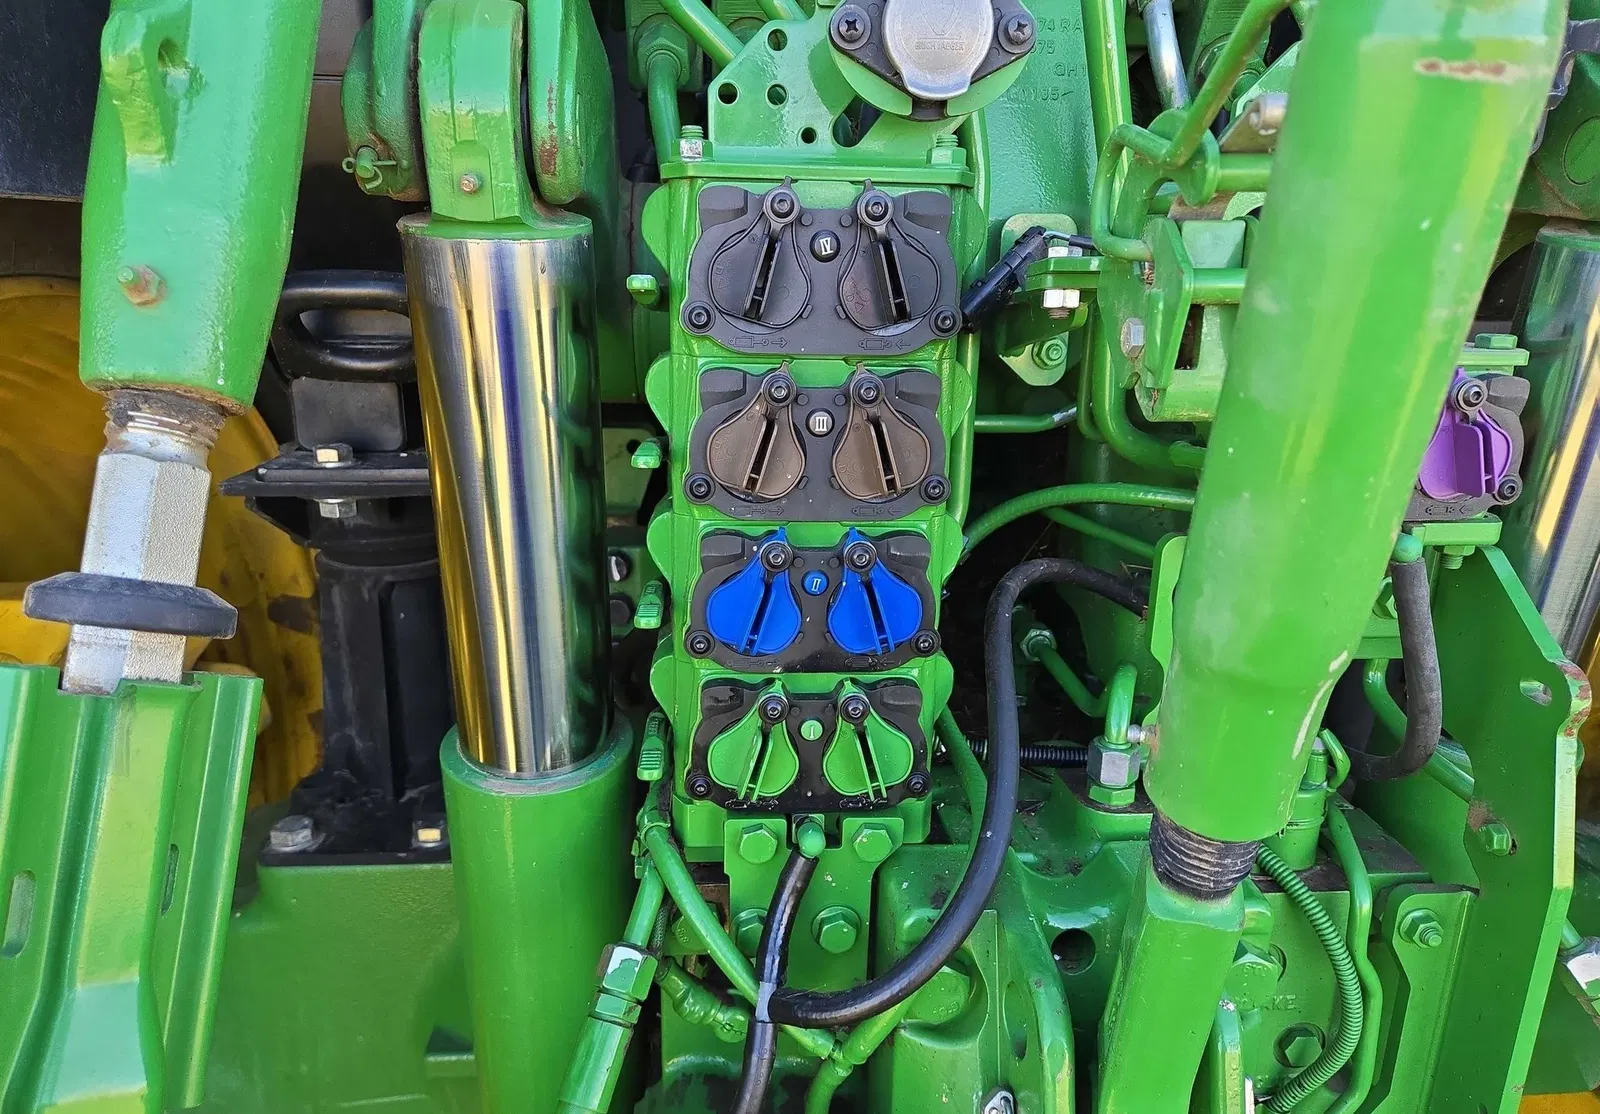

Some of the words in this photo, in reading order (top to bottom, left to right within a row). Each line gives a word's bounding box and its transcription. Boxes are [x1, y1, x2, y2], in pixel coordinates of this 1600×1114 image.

[819, 237, 834, 255] IV
[814, 416, 828, 432] III
[811, 578, 822, 592] II
